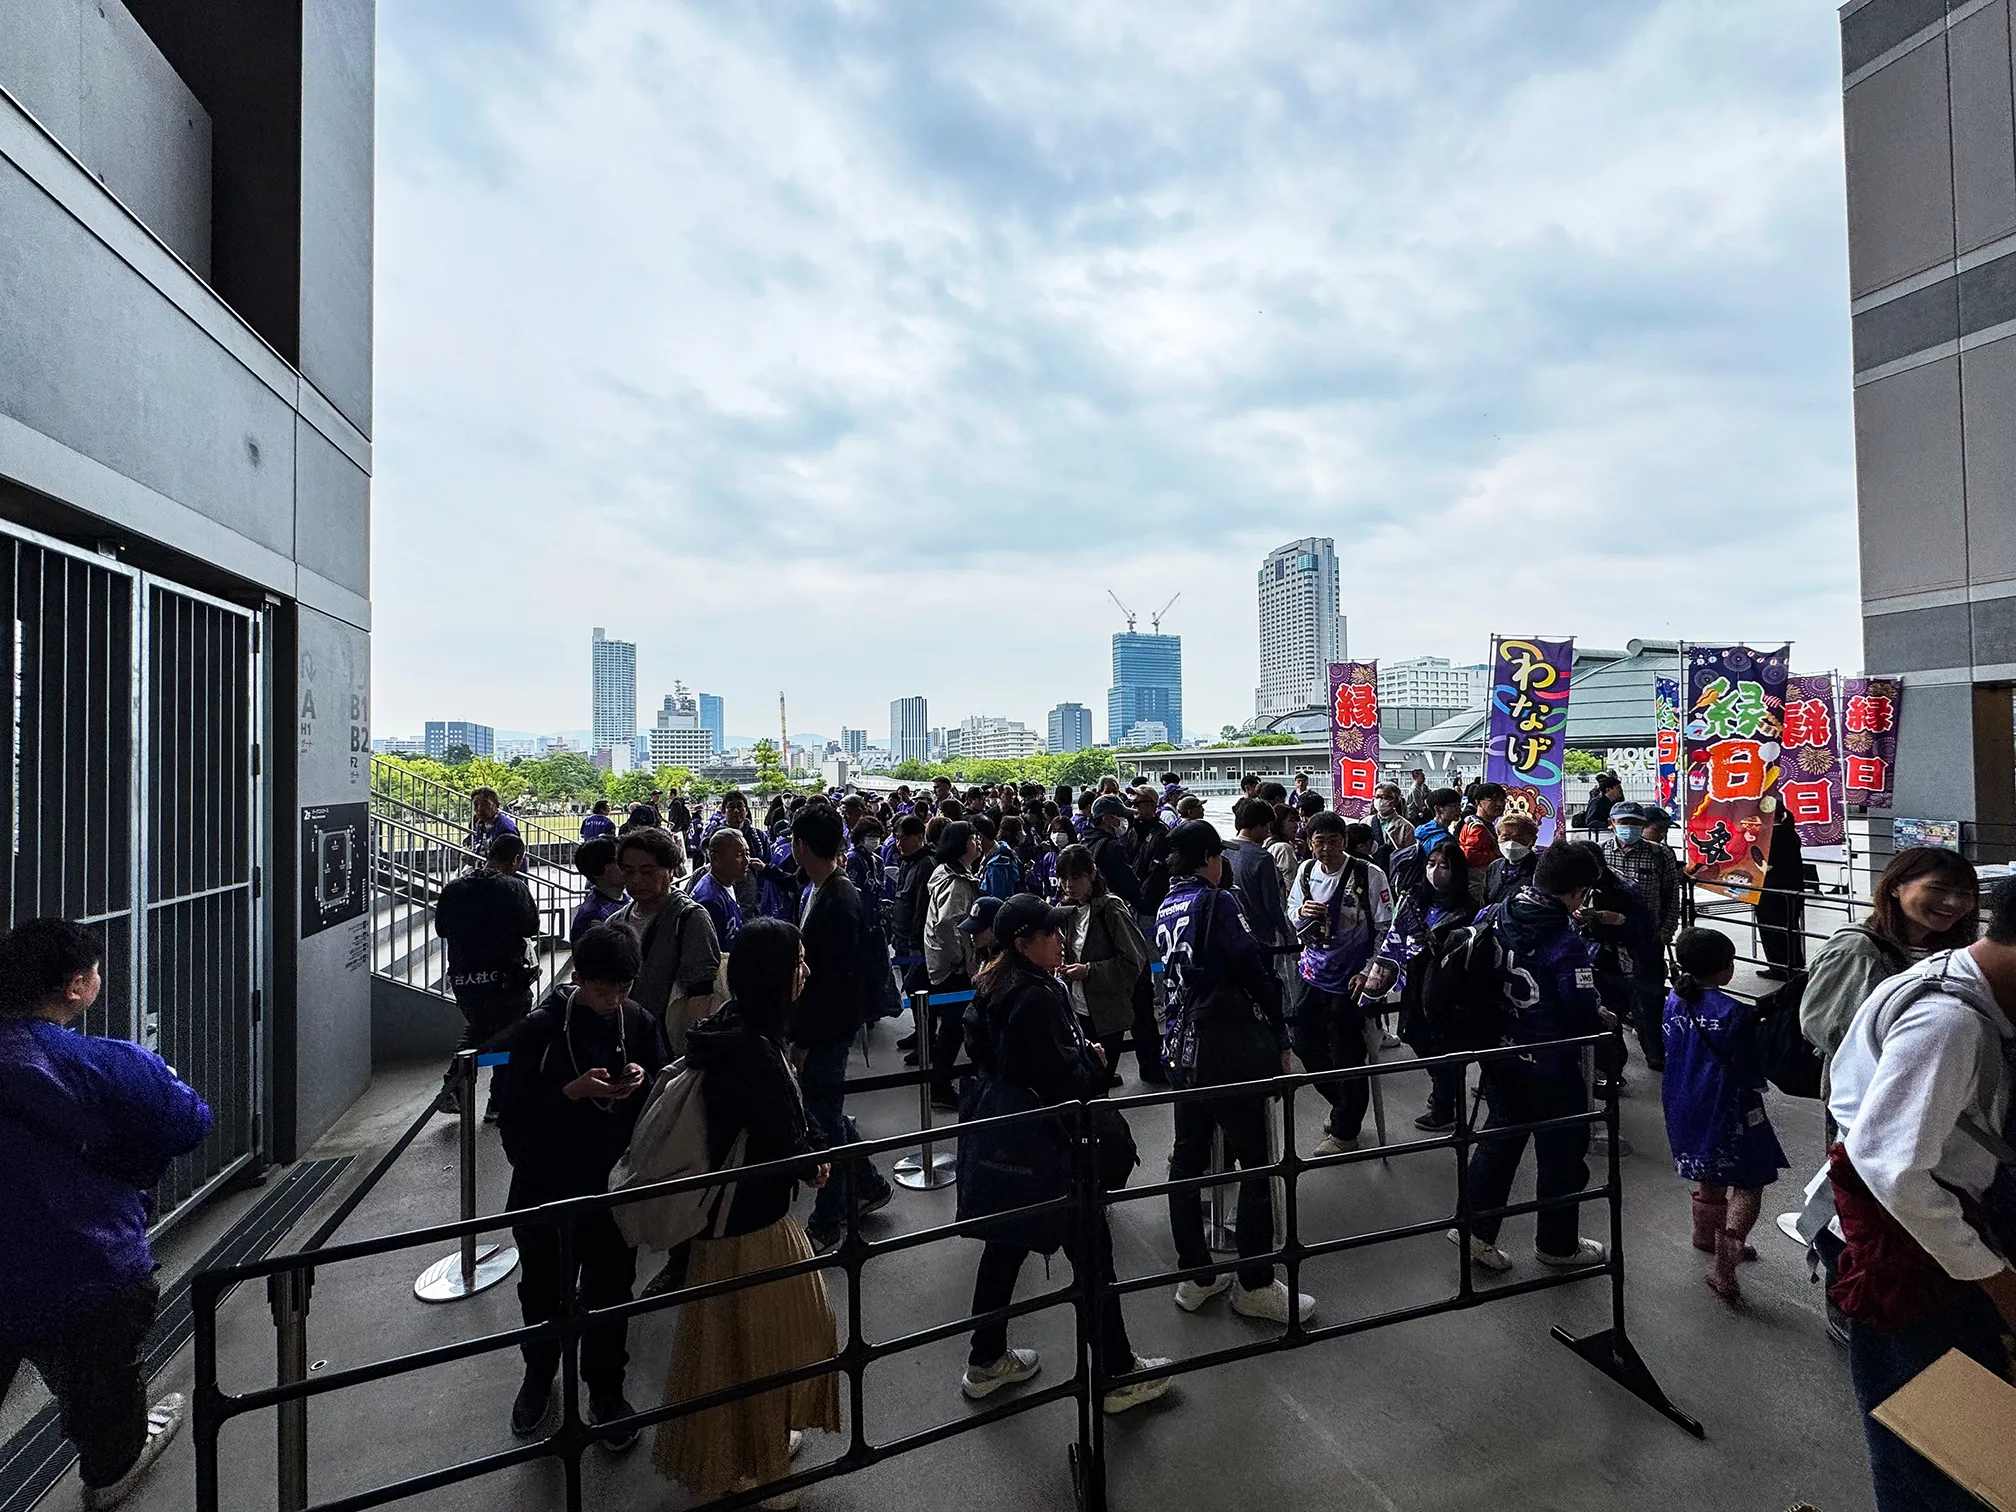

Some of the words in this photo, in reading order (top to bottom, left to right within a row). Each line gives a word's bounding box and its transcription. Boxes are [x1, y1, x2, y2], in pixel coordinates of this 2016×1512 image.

[301, 689, 317, 720] A
[350, 694, 368, 722] B1
[1507, 650, 1557, 773] わなげ
[300, 722, 311, 736] H1
[350, 725, 370, 753] B2
[1335, 682, 1379, 801] 縁日
[1703, 677, 1769, 802] 縁日
[1845, 695, 1894, 792] 縁日
[350, 756, 358, 768] F2
